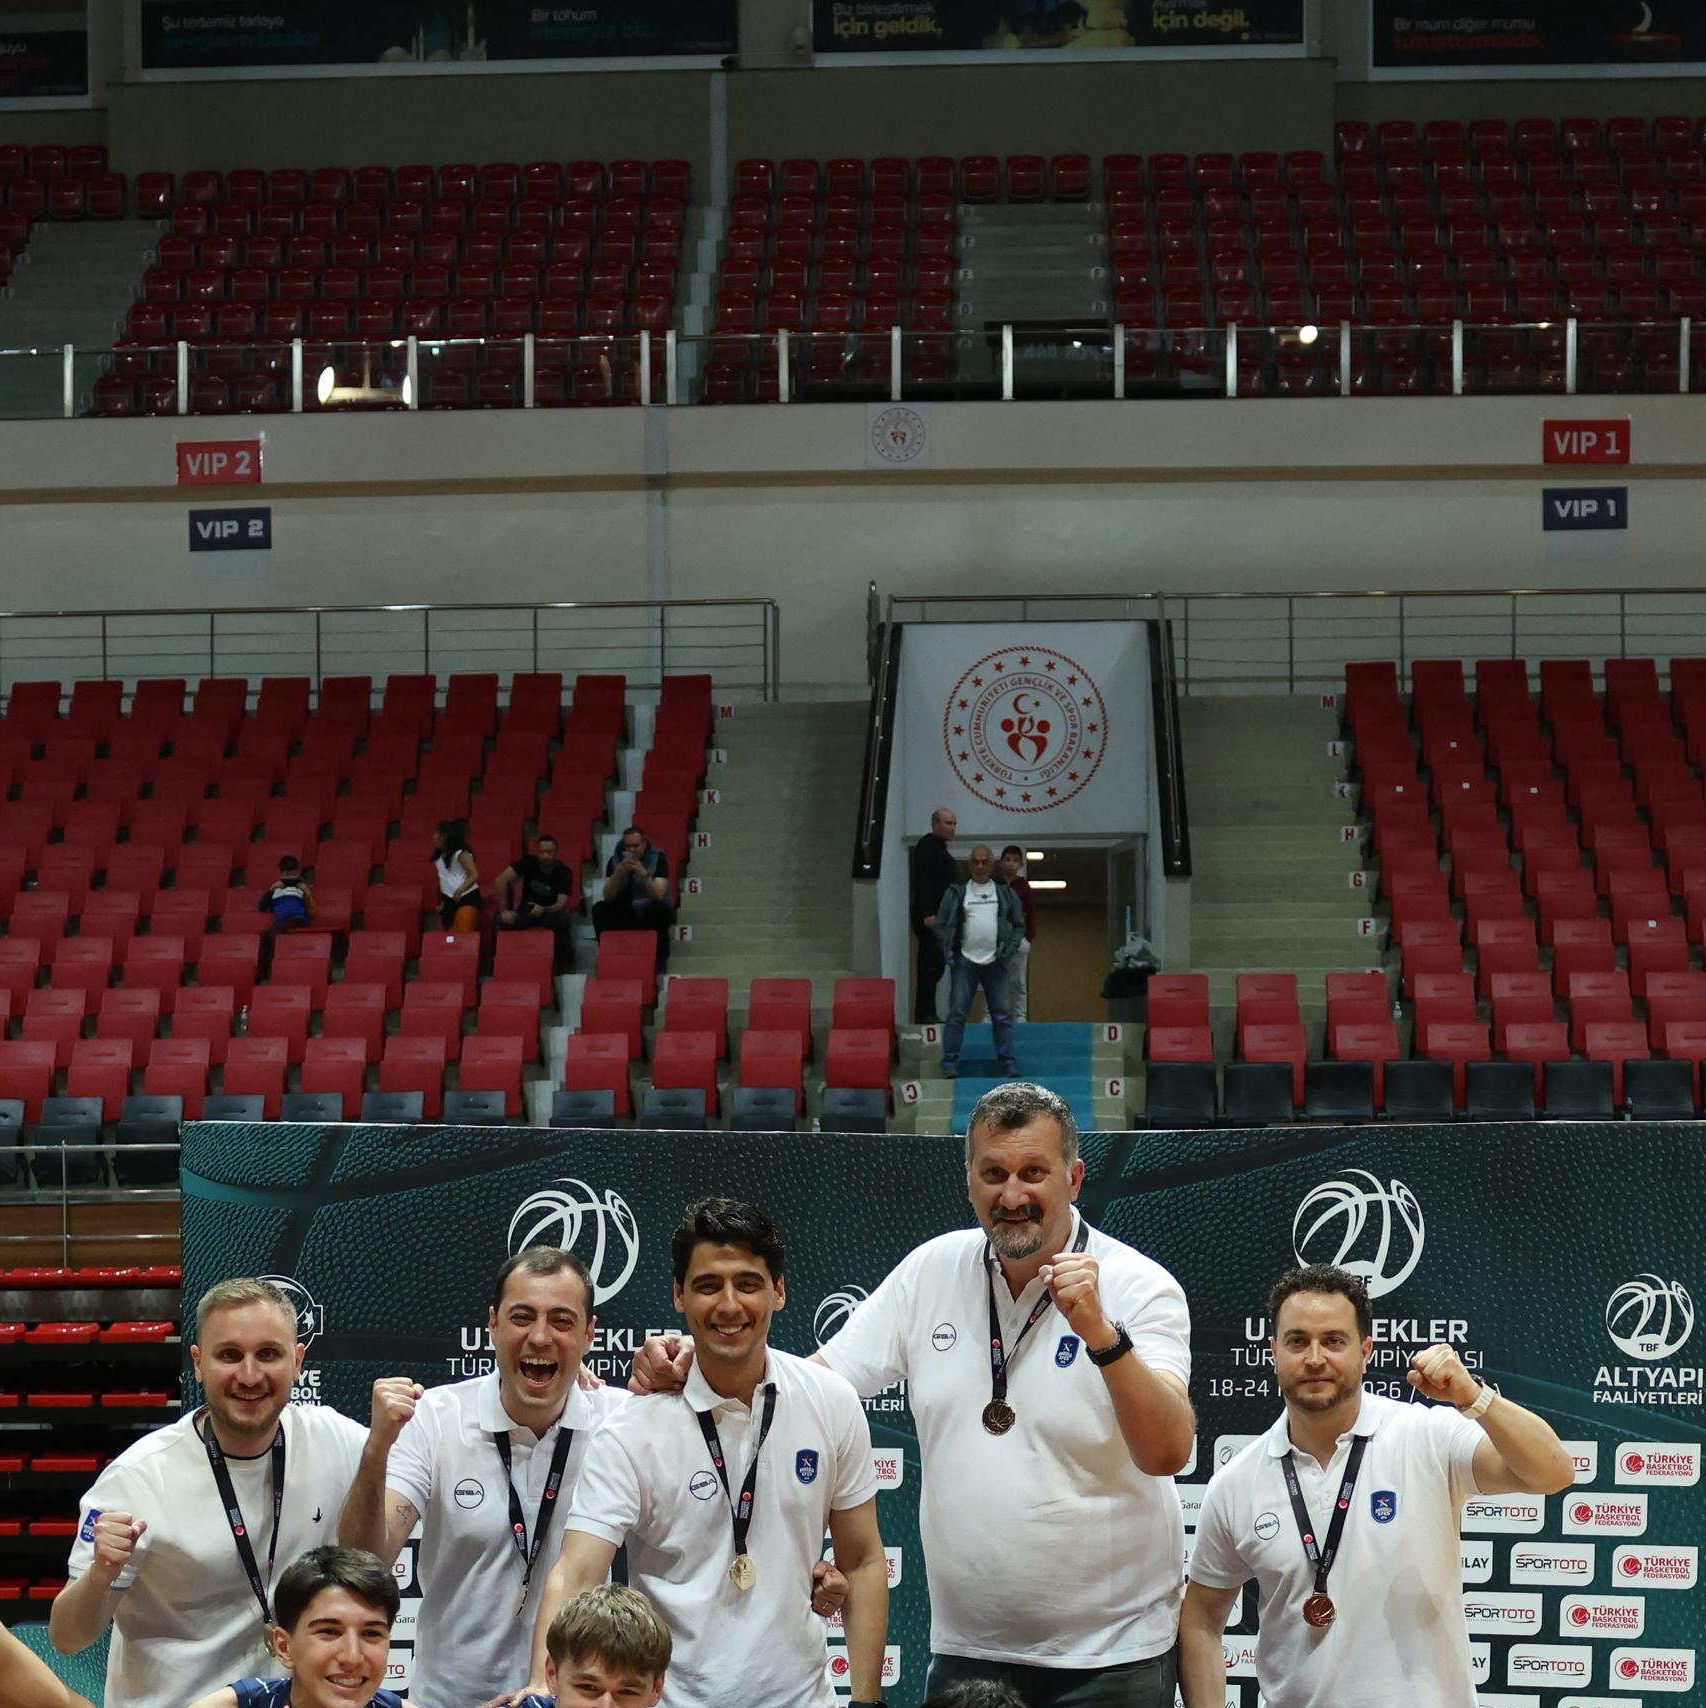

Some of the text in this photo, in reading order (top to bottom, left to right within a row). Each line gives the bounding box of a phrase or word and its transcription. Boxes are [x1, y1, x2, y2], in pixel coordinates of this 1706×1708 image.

[1193, 10, 1251, 31] değil.
[873, 16, 943, 39] geldik,
[1554, 431, 1621, 455] VIP 1
[186, 450, 251, 476] VIP 2
[1555, 499, 1616, 517] VIP 1
[196, 519, 264, 538] VIP 2
[1353, 873, 1362, 887] G
[1363, 920, 1371, 934] F
[927, 1027, 936, 1042] D
[1108, 1026, 1118, 1041] D
[1110, 1080, 1120, 1096] C
[1371, 1319, 1468, 1343] EKLER
[1638, 1343, 1660, 1352] TBF
[1594, 1366, 1703, 1388] ALTYAPI
[1209, 1379, 1270, 1398] 18-24
[1593, 1388, 1703, 1405] FAALİYETLERİ
[1646, 1452, 1693, 1464] TÜRKİYE
[1646, 1463, 1693, 1471] BASKETBOL
[689, 1478, 717, 1492] GSA
[455, 1488, 483, 1496] GSA
[1467, 1505, 1538, 1518] SPORTOTO
[1595, 1502, 1641, 1515] TÜRKİYE
[1595, 1513, 1641, 1522] BASKETBOL
[1516, 1557, 1587, 1570] SPORTOTO
[1644, 1555, 1690, 1567] TÜRKİYE
[1644, 1566, 1690, 1575] BASKETBOL
[1464, 1607, 1535, 1620] SPORTOTO
[1593, 1605, 1638, 1617] TÜRKİYE
[1592, 1616, 1638, 1624] BASKETBOL
[1513, 1659, 1585, 1672] SPORTOTO
[1641, 1658, 1687, 1670] TÜRKİYE
[1641, 1669, 1687, 1677] BASKETBOL
